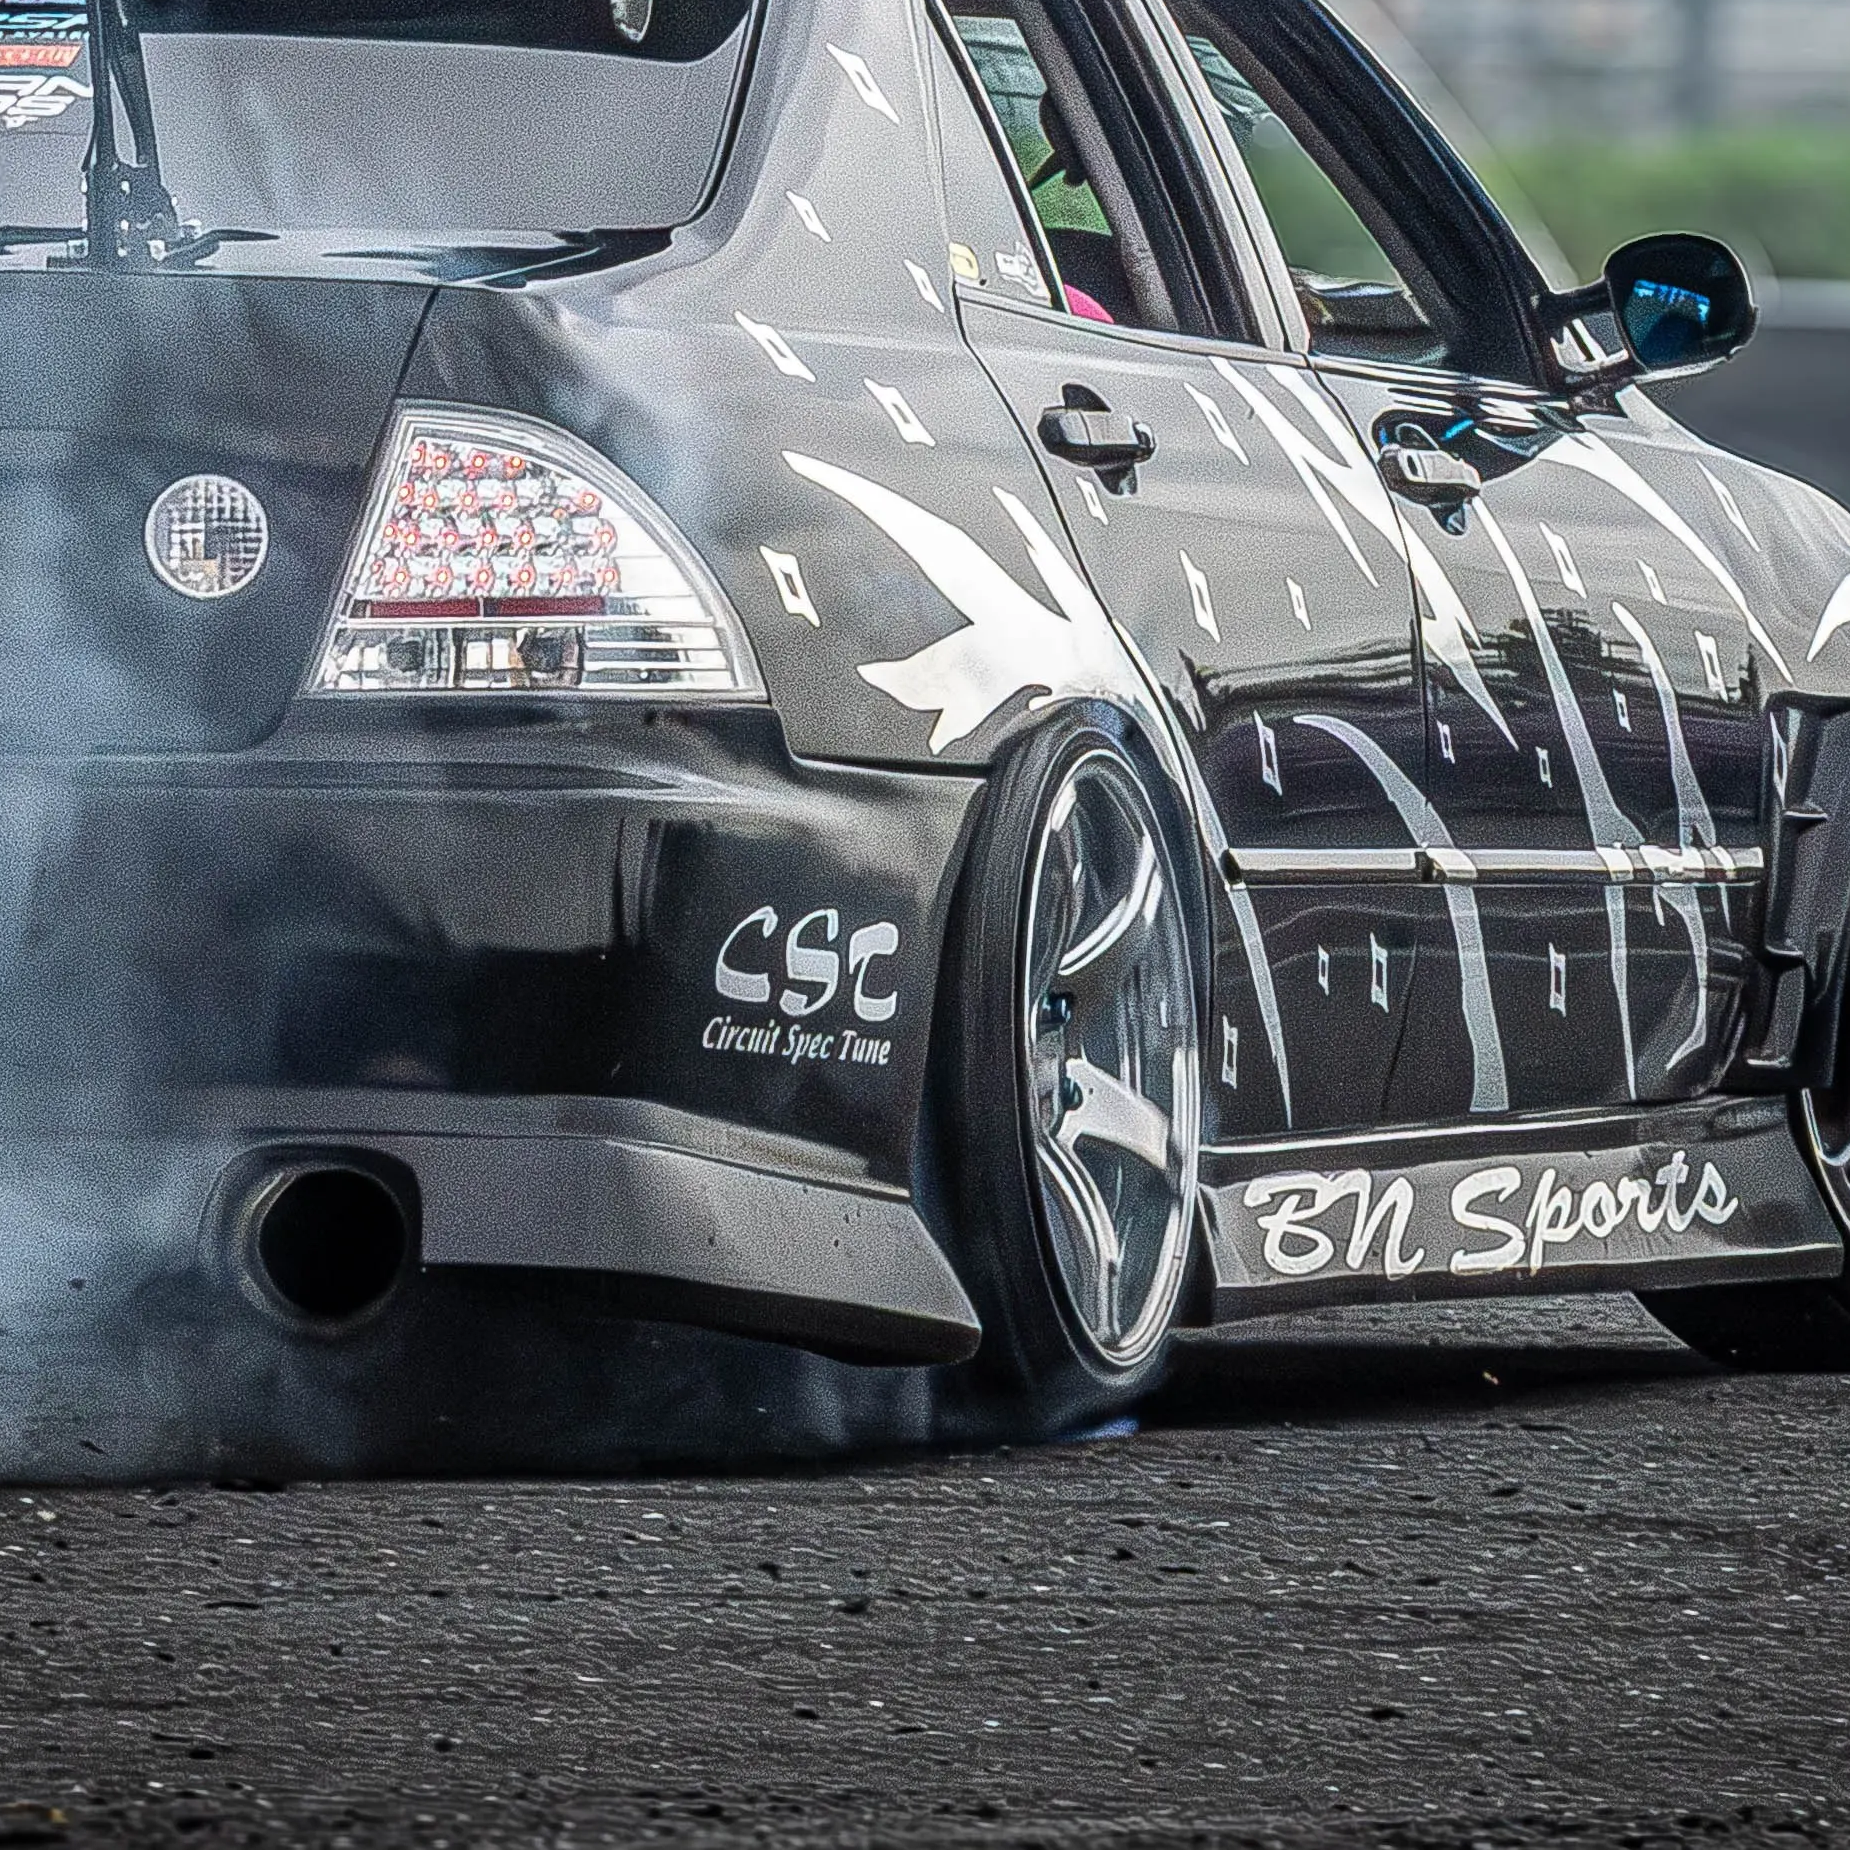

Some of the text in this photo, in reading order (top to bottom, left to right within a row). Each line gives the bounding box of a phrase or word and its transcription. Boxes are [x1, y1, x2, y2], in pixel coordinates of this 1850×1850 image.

[702, 1015, 892, 1066] Circuit Spec Tune
[1244, 1150, 1739, 1281] BN Sports
